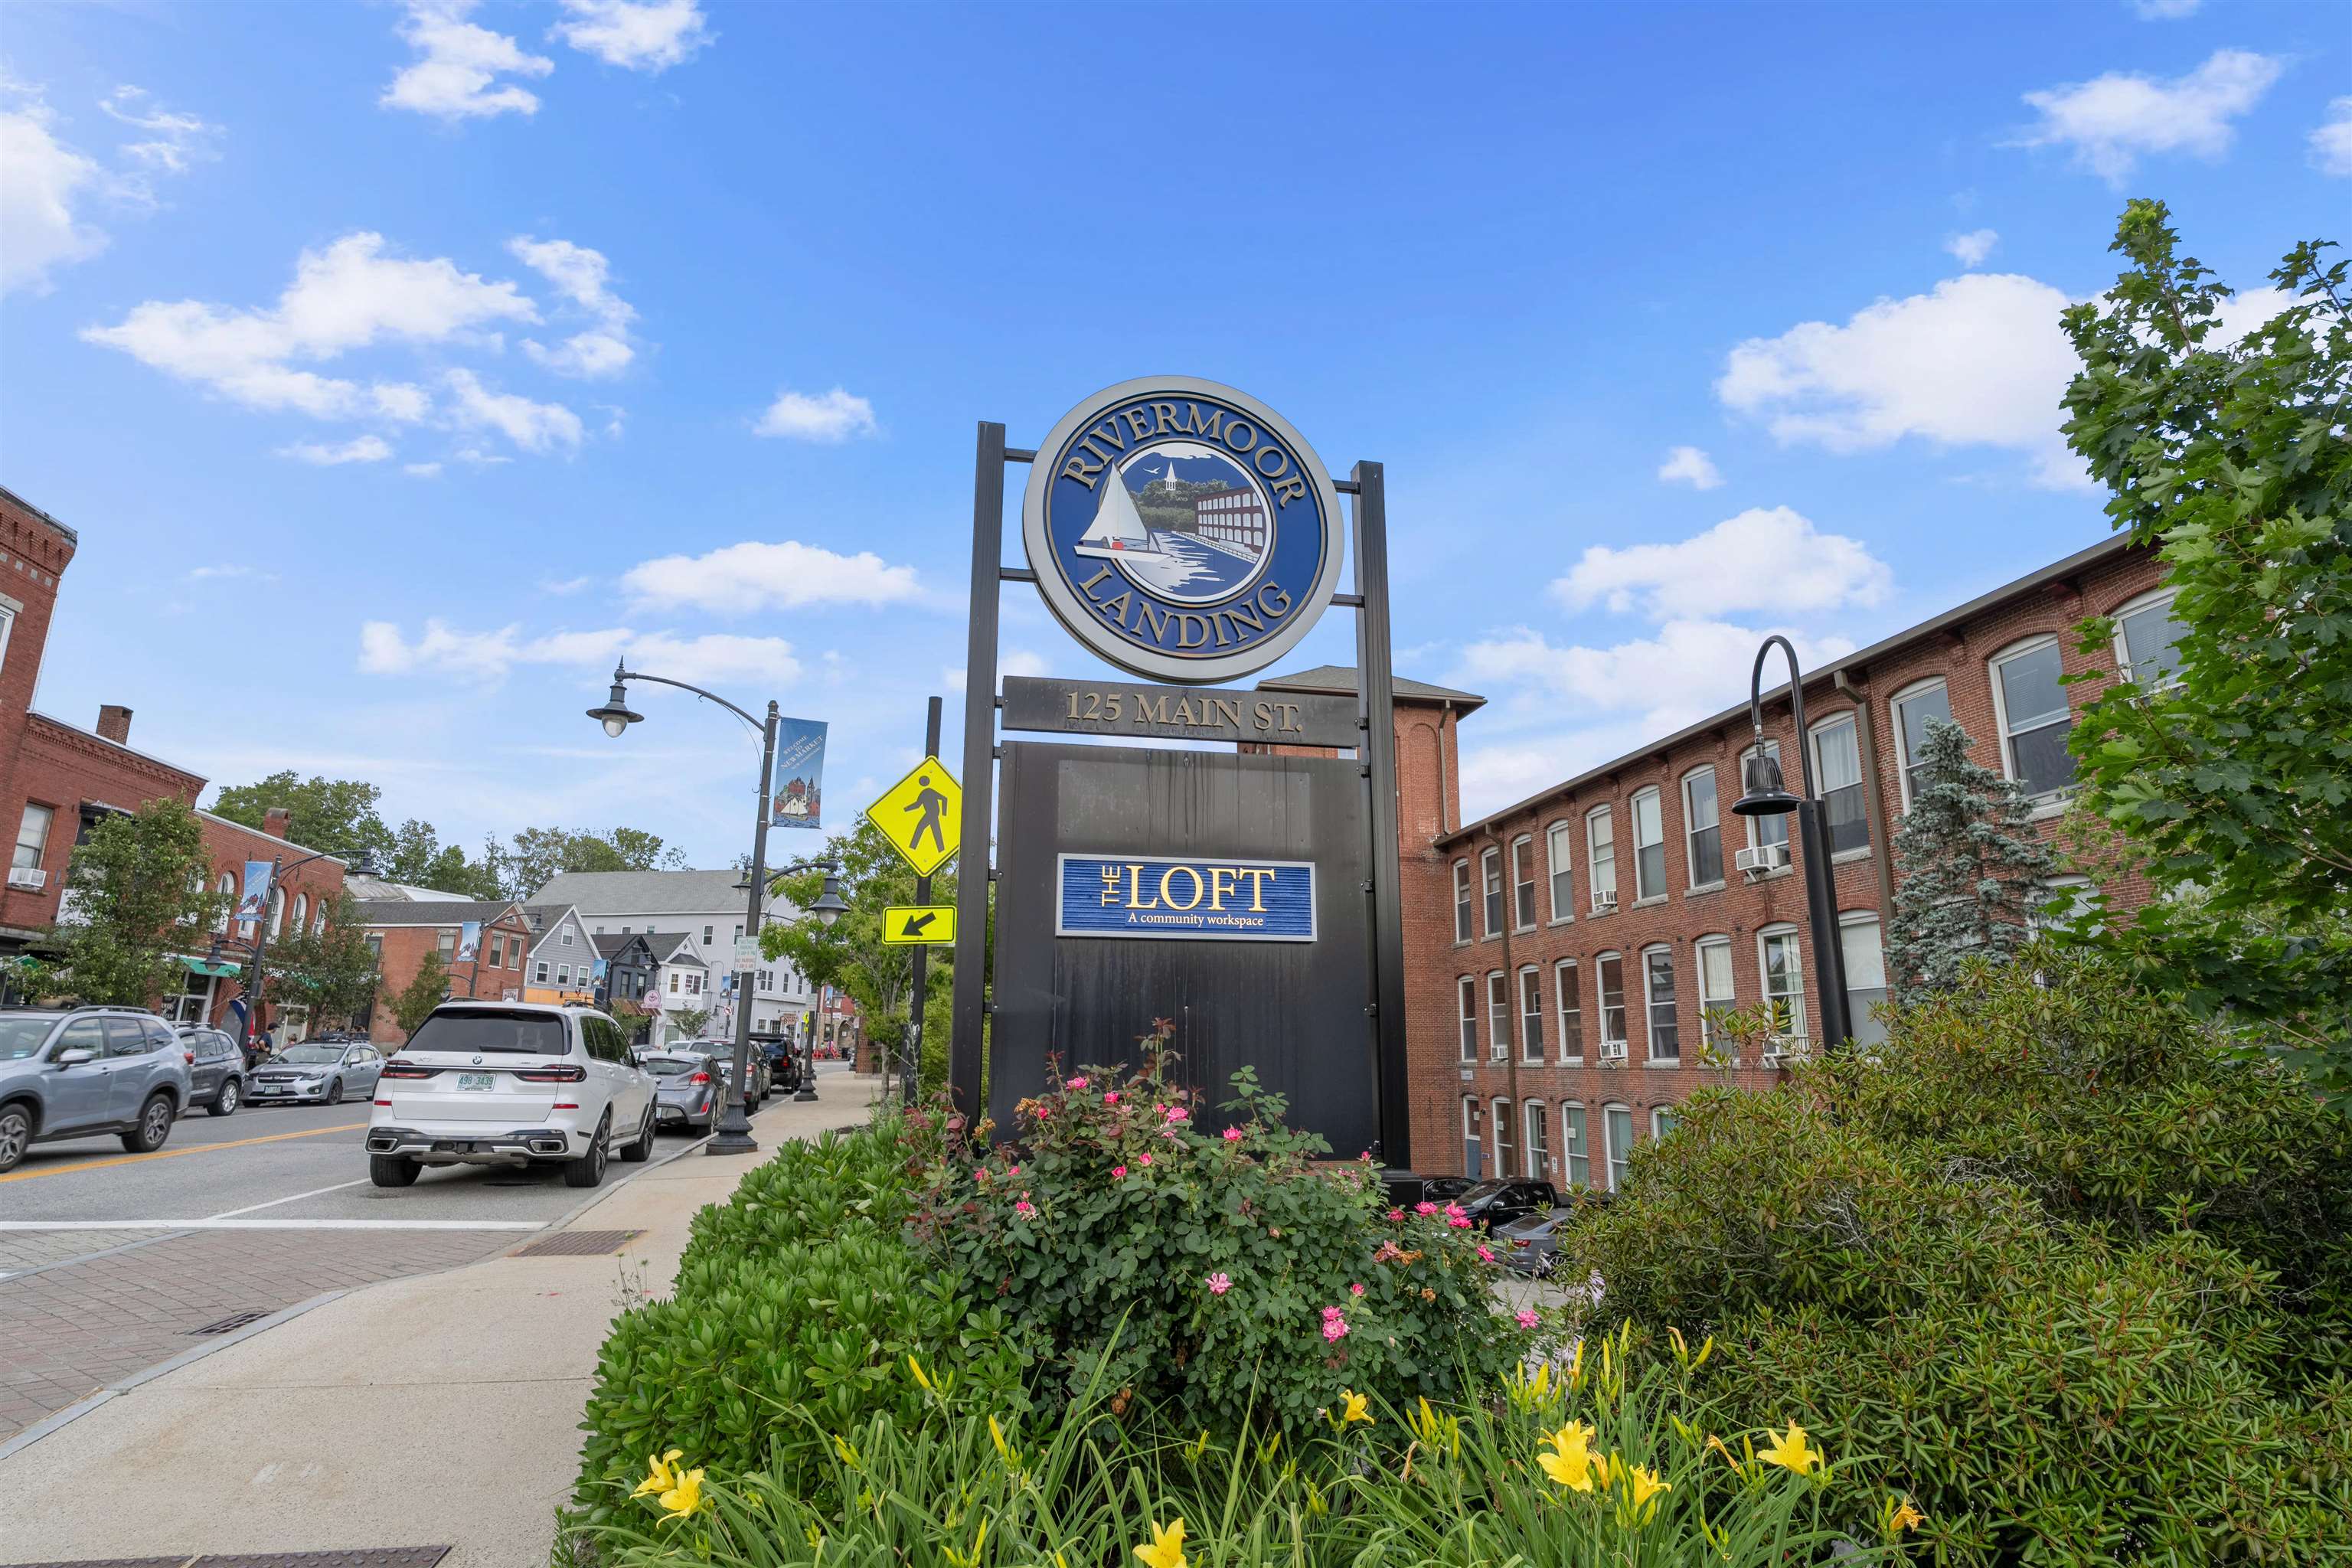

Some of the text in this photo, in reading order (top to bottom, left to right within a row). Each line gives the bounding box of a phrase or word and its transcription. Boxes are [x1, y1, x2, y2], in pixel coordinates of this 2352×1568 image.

[1061, 403, 1306, 510] RIVERMOOR
[1078, 564, 1292, 648] LANDING
[1067, 691, 1303, 732] 125 MAIN ST.
[782, 734, 808, 755] WELCOME
[1101, 865, 1121, 906] THE
[1125, 865, 1275, 912] LOFT
[1128, 912, 1263, 929] A community workspace
